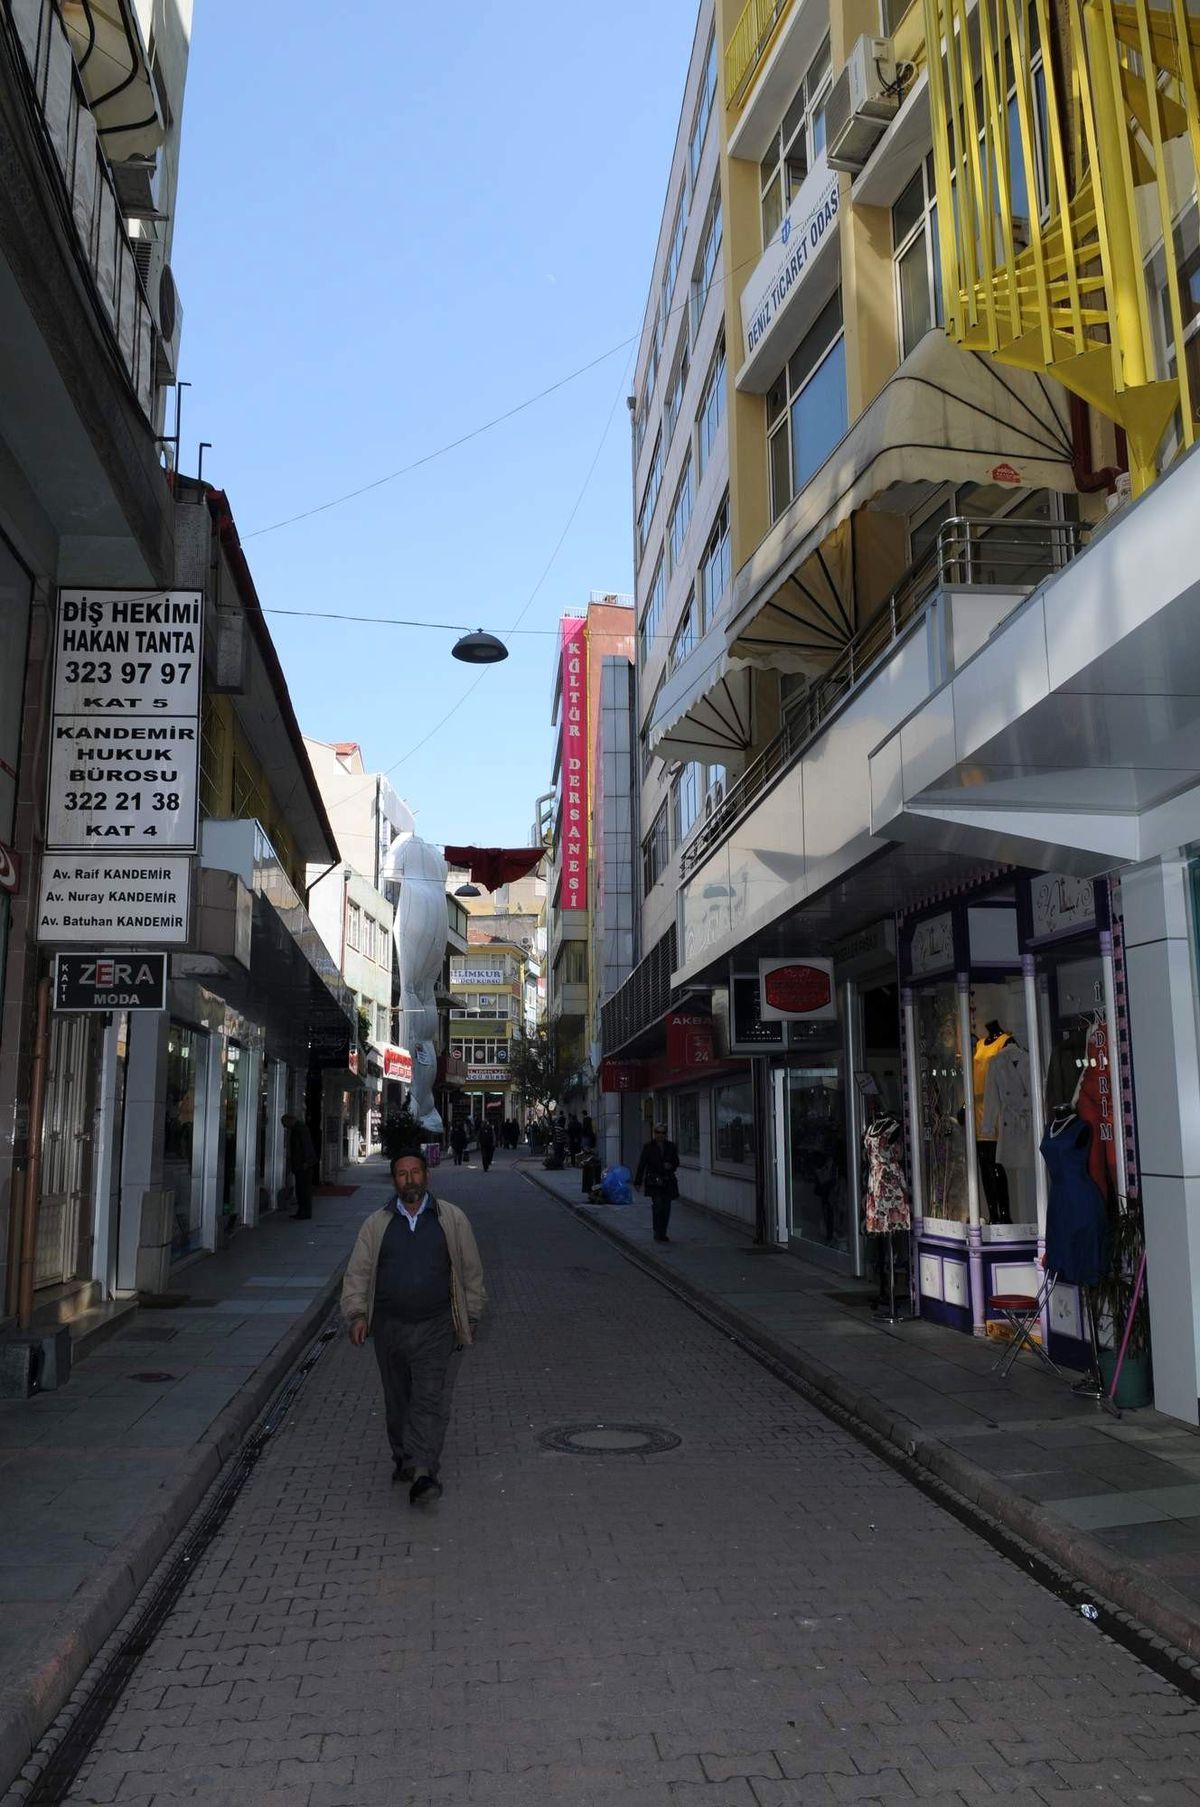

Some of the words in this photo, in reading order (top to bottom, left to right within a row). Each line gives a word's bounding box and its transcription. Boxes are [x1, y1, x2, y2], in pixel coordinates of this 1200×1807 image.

[747, 303, 772, 353] DENİZ
[771, 237, 810, 311] TİCARET
[62, 596, 103, 628] DİŞ
[113, 597, 199, 624] HEKİMİ
[62, 629, 128, 653] HAKAN
[136, 631, 195, 654] TANTA
[64, 661, 113, 684] 323
[121, 662, 152, 685] 97
[161, 663, 192, 685] 97
[568, 643, 581, 737] KÜLTÜR
[83, 697, 142, 709] KAT
[152, 697, 168, 709] 5
[56, 725, 195, 741] KANDEMİR
[77, 747, 172, 761] HUKUK
[69, 766, 178, 783] BÜROSU
[64, 792, 107, 811] 322
[115, 792, 142, 811] 21
[151, 792, 180, 812] 38
[85, 825, 135, 837] KAT
[141, 825, 158, 837] 4
[568, 758, 581, 907] DERSANESİ
[52, 868, 72, 880] Av.
[75, 868, 100, 880] Raif
[104, 867, 171, 881] KANDEMİR
[46, 891, 65, 903] Av.
[68, 891, 105, 906] Nuray
[108, 890, 177, 904] KANDEMİR
[41, 915, 60, 927] Av.
[63, 915, 113, 928] Batuhan
[117, 914, 183, 929] KANDEMİR
[79, 960, 155, 986] ZERA
[93, 992, 140, 1005] MODA
